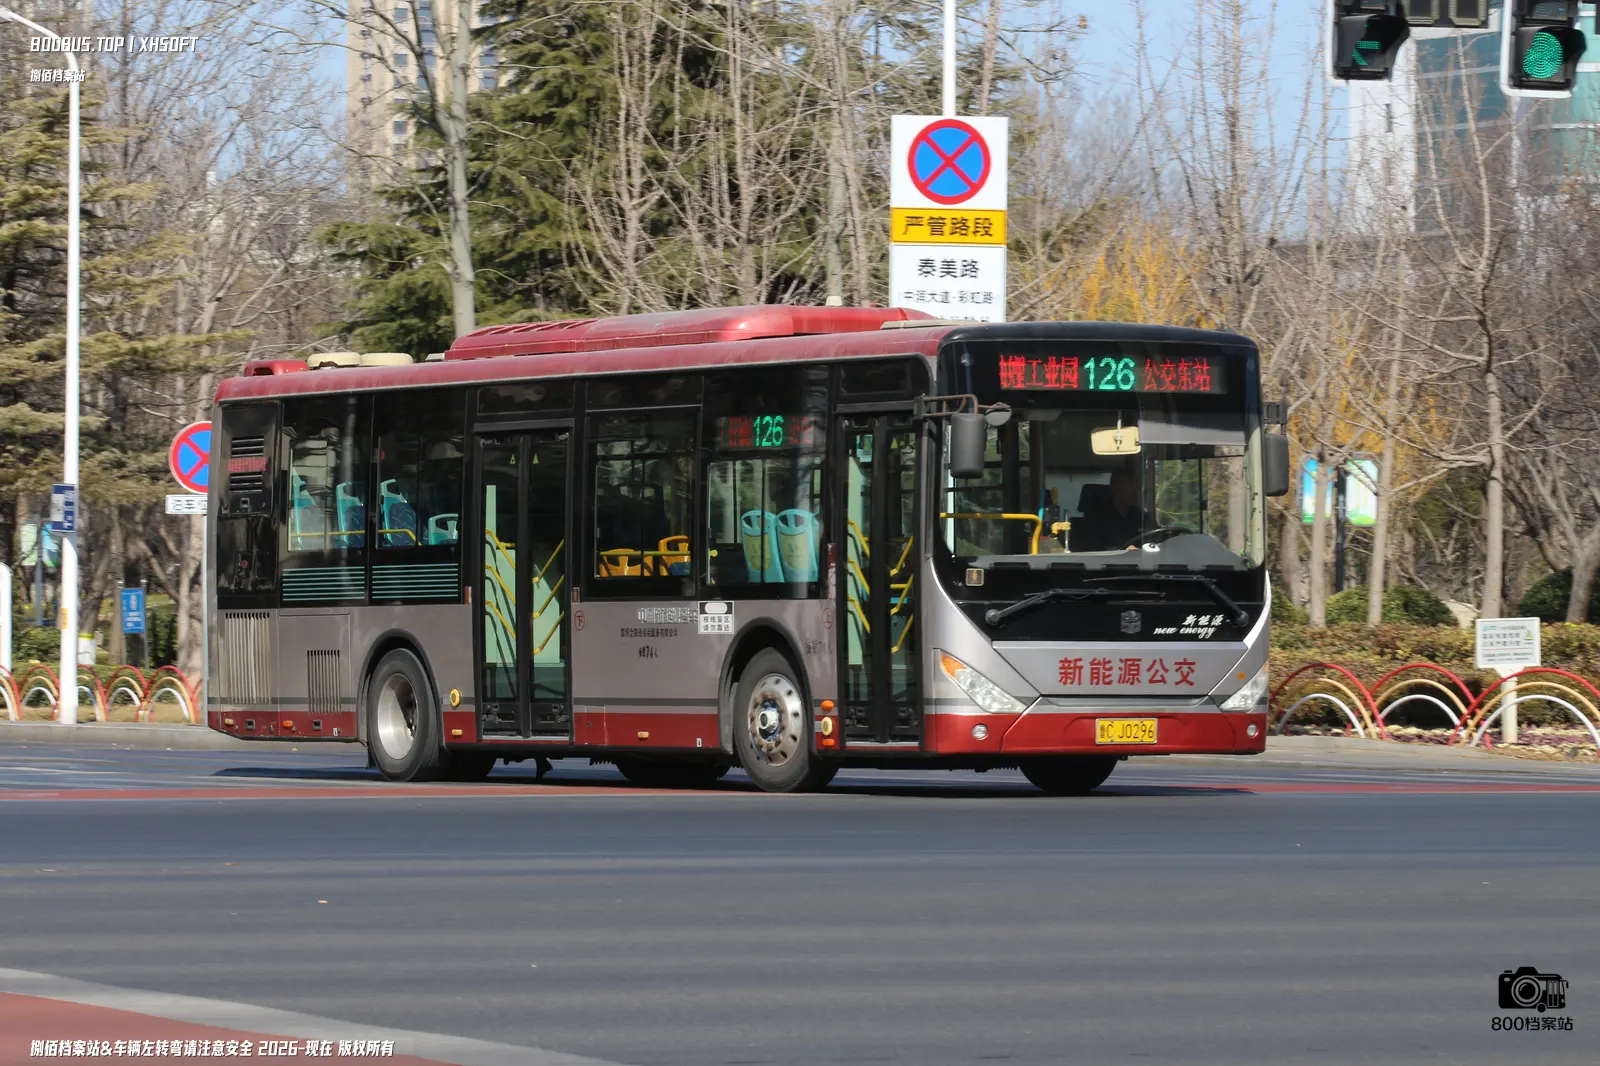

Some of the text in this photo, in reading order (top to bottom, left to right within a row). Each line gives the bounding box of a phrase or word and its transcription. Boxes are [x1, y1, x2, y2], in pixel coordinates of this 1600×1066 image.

[902, 215, 993, 237] 严管路段
[917, 258, 980, 279] 泰美路
[1083, 357, 1136, 390] 126
[1142, 358, 1211, 392] 公交东站
[753, 415, 784, 447] 126
[1181, 614, 1224, 626] 新能源
[1153, 626, 1217, 639] new energy
[1058, 657, 1197, 686] 新能源公交
